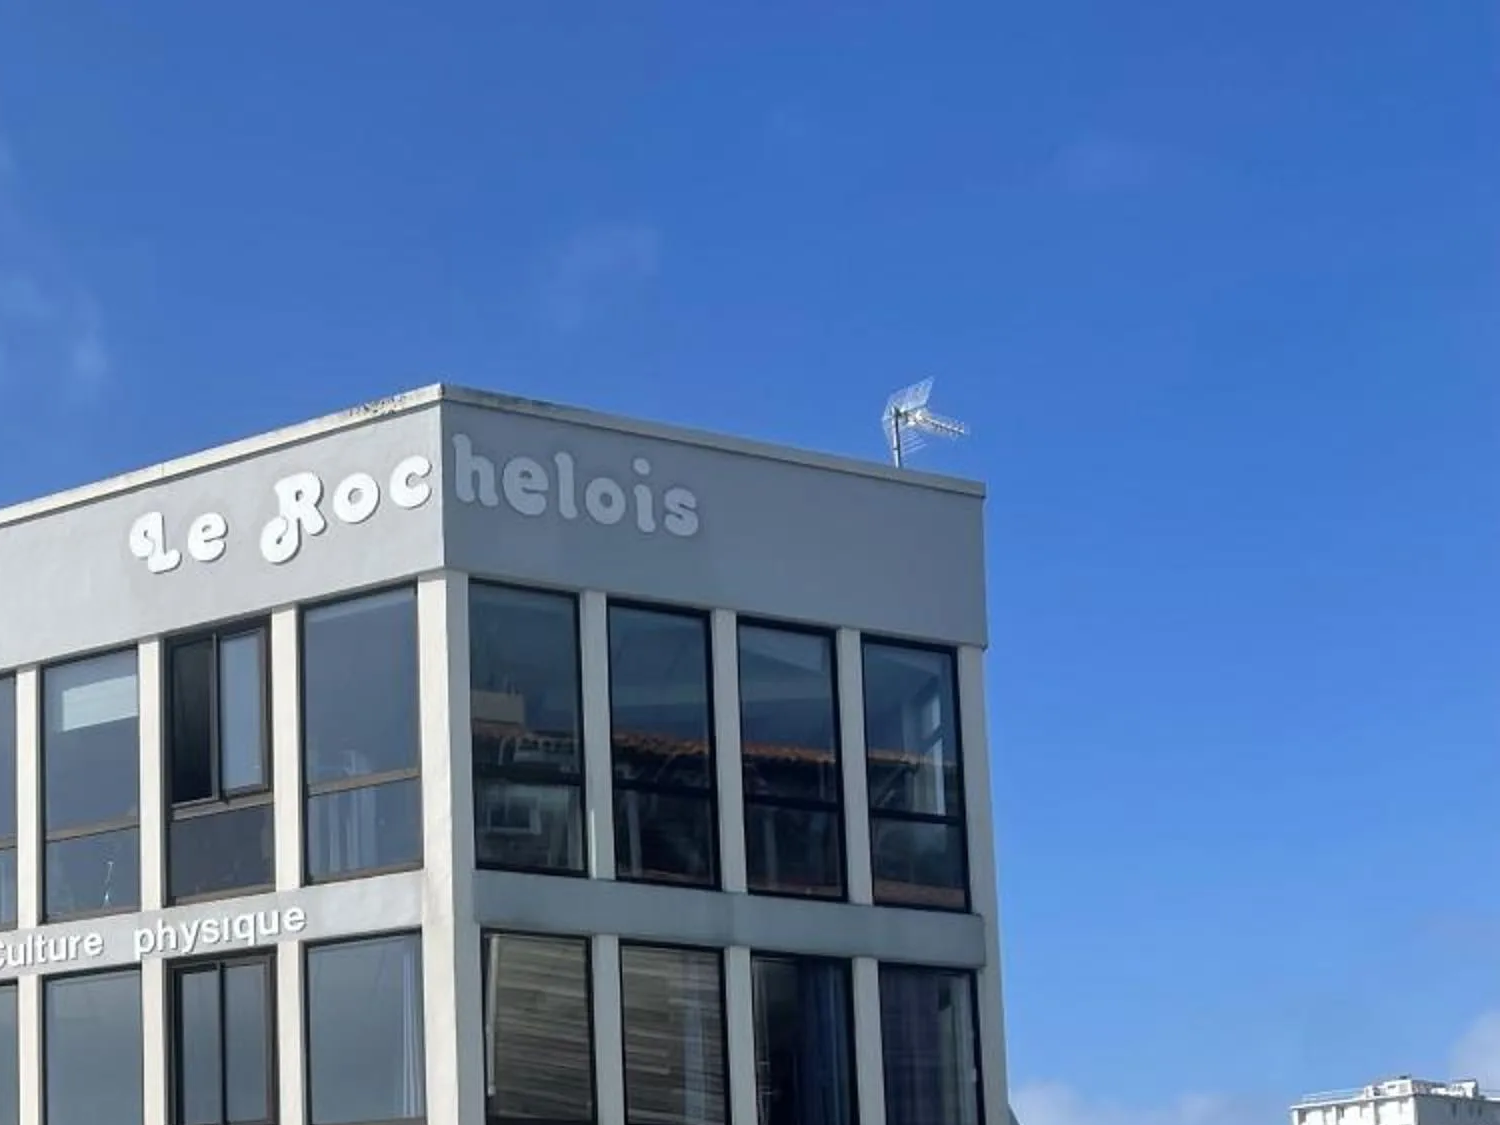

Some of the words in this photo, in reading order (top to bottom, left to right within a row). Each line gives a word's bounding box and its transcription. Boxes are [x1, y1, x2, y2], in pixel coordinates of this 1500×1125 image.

[129, 511, 228, 574] Le
[259, 433, 699, 564] Rochelois
[134, 905, 307, 957] physique
